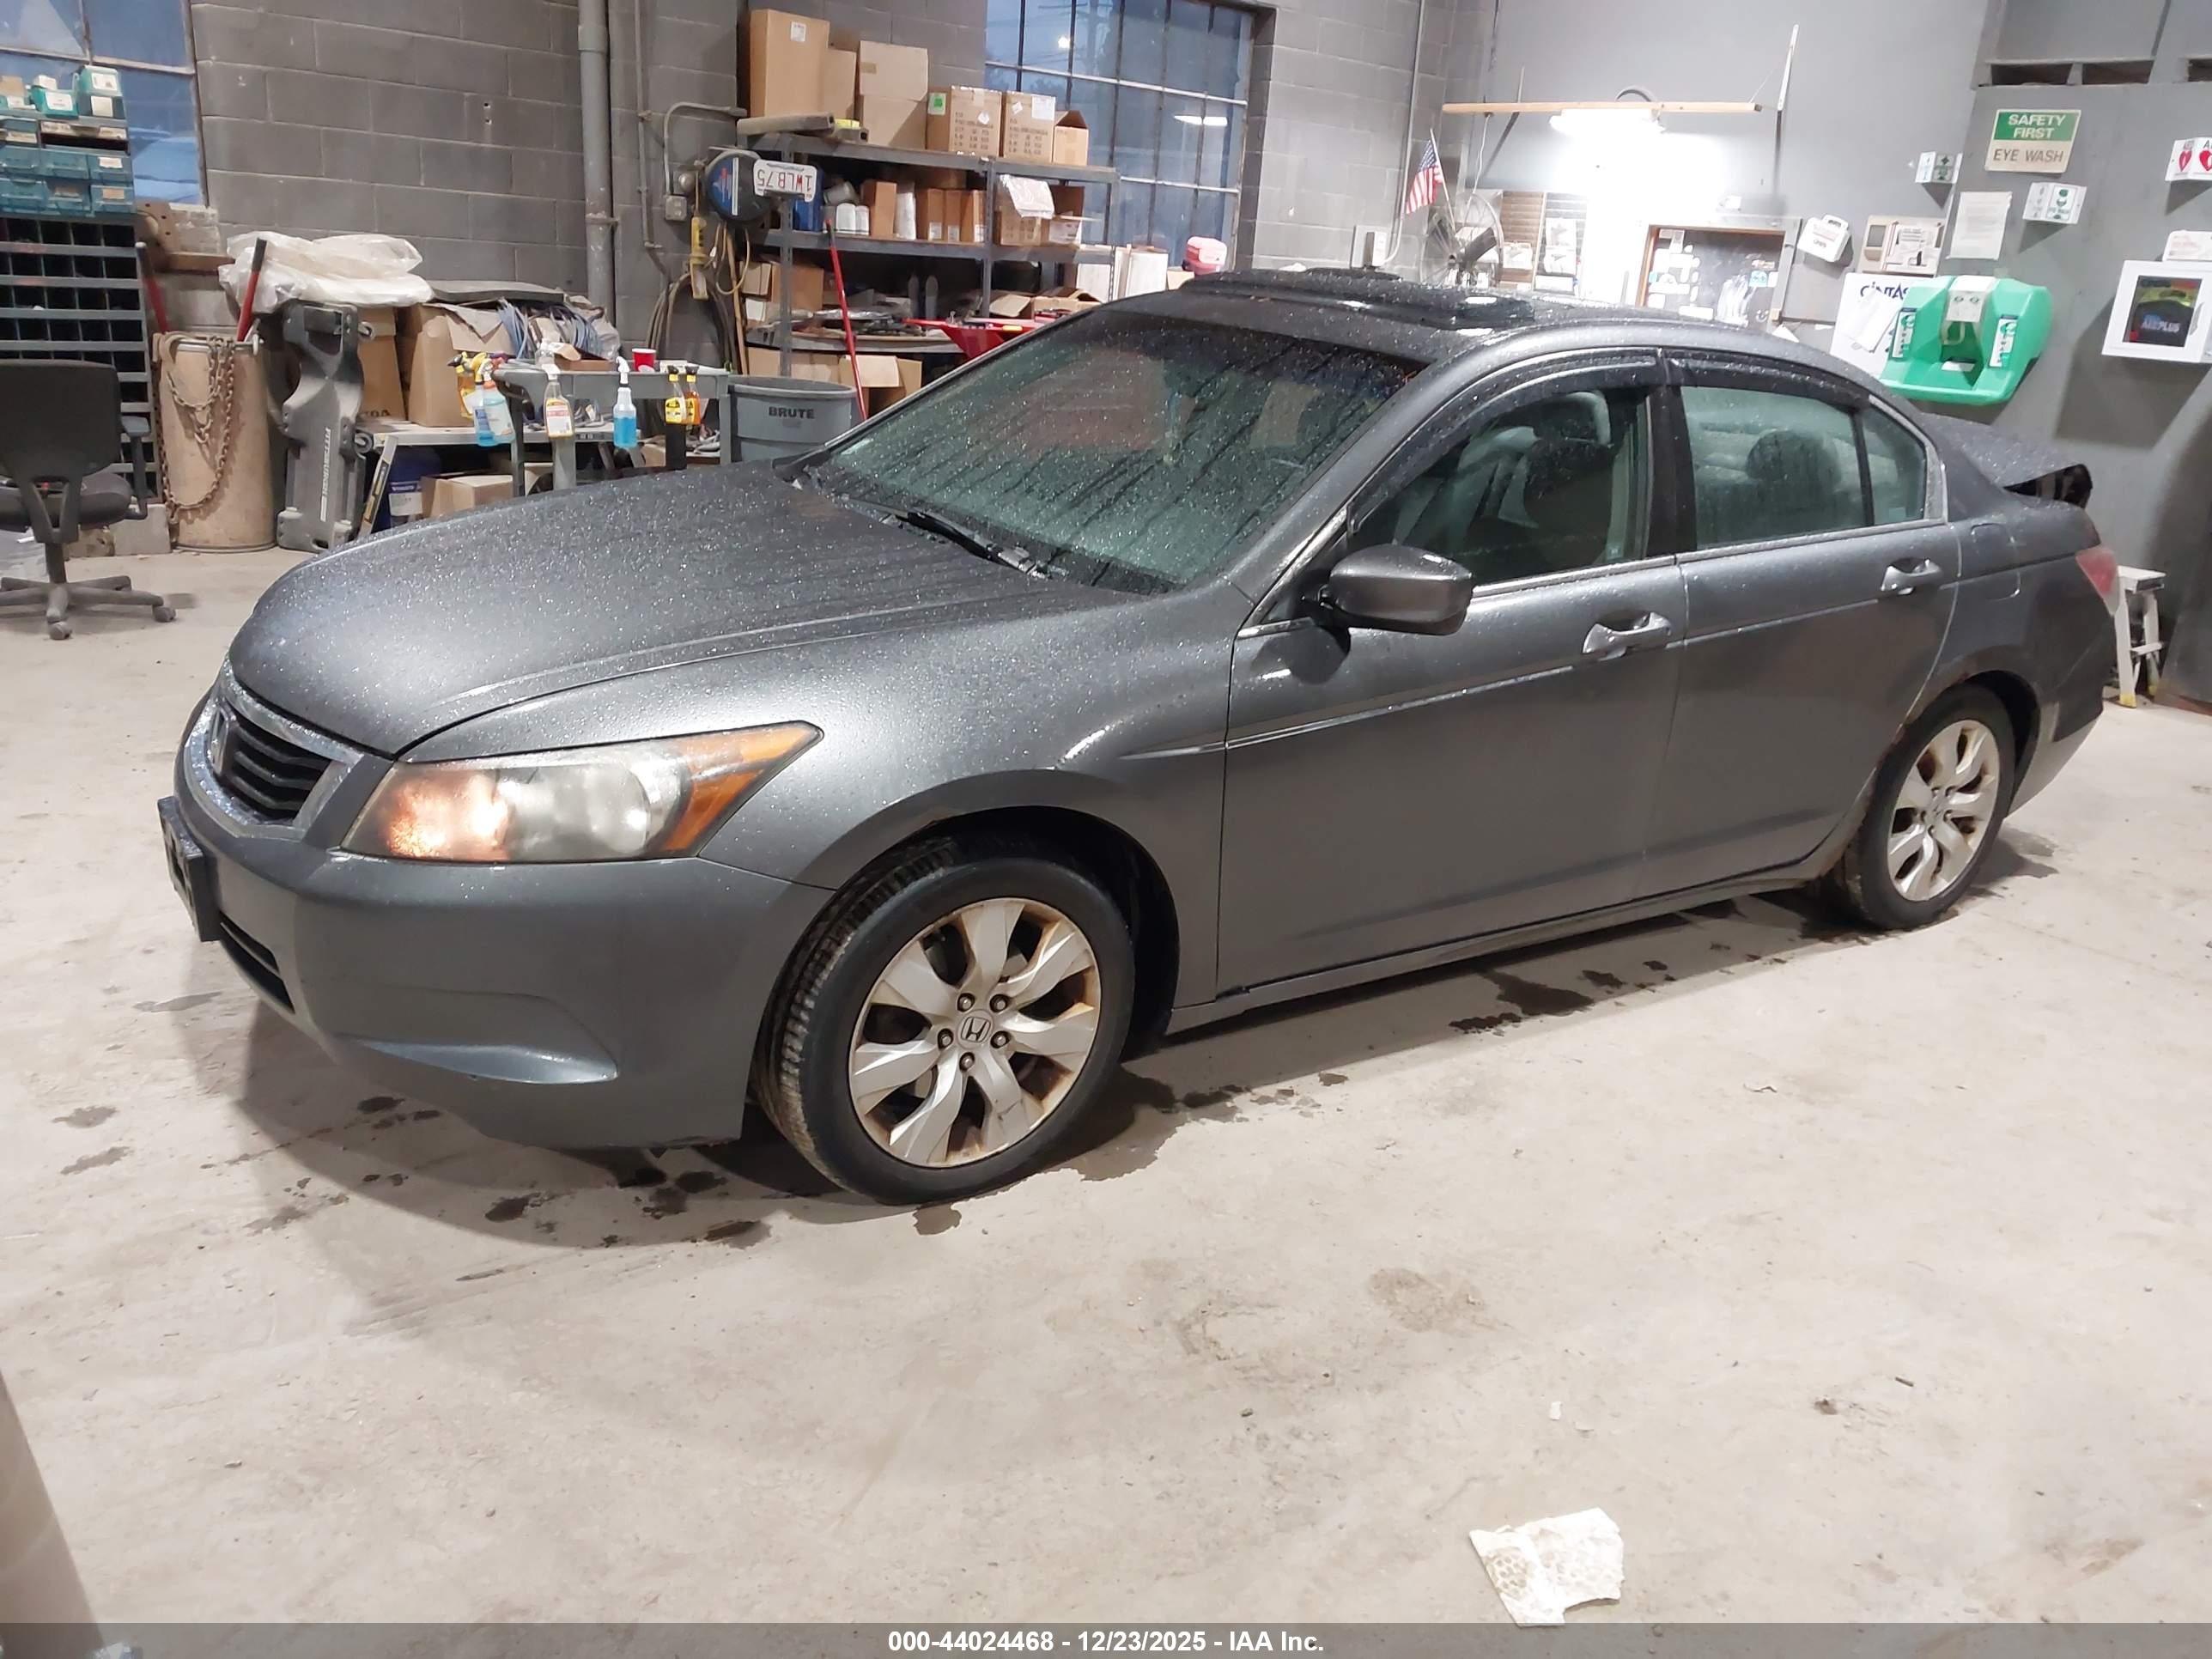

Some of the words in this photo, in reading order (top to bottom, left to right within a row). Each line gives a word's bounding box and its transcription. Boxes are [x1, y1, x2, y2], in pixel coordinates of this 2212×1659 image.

[2008, 114, 2067, 126] SAFETY
[2013, 127, 2056, 139] FIRST
[1993, 149, 2020, 161] EYE
[2025, 150, 2064, 163] WASH
[769, 406, 815, 419] BRUTE
